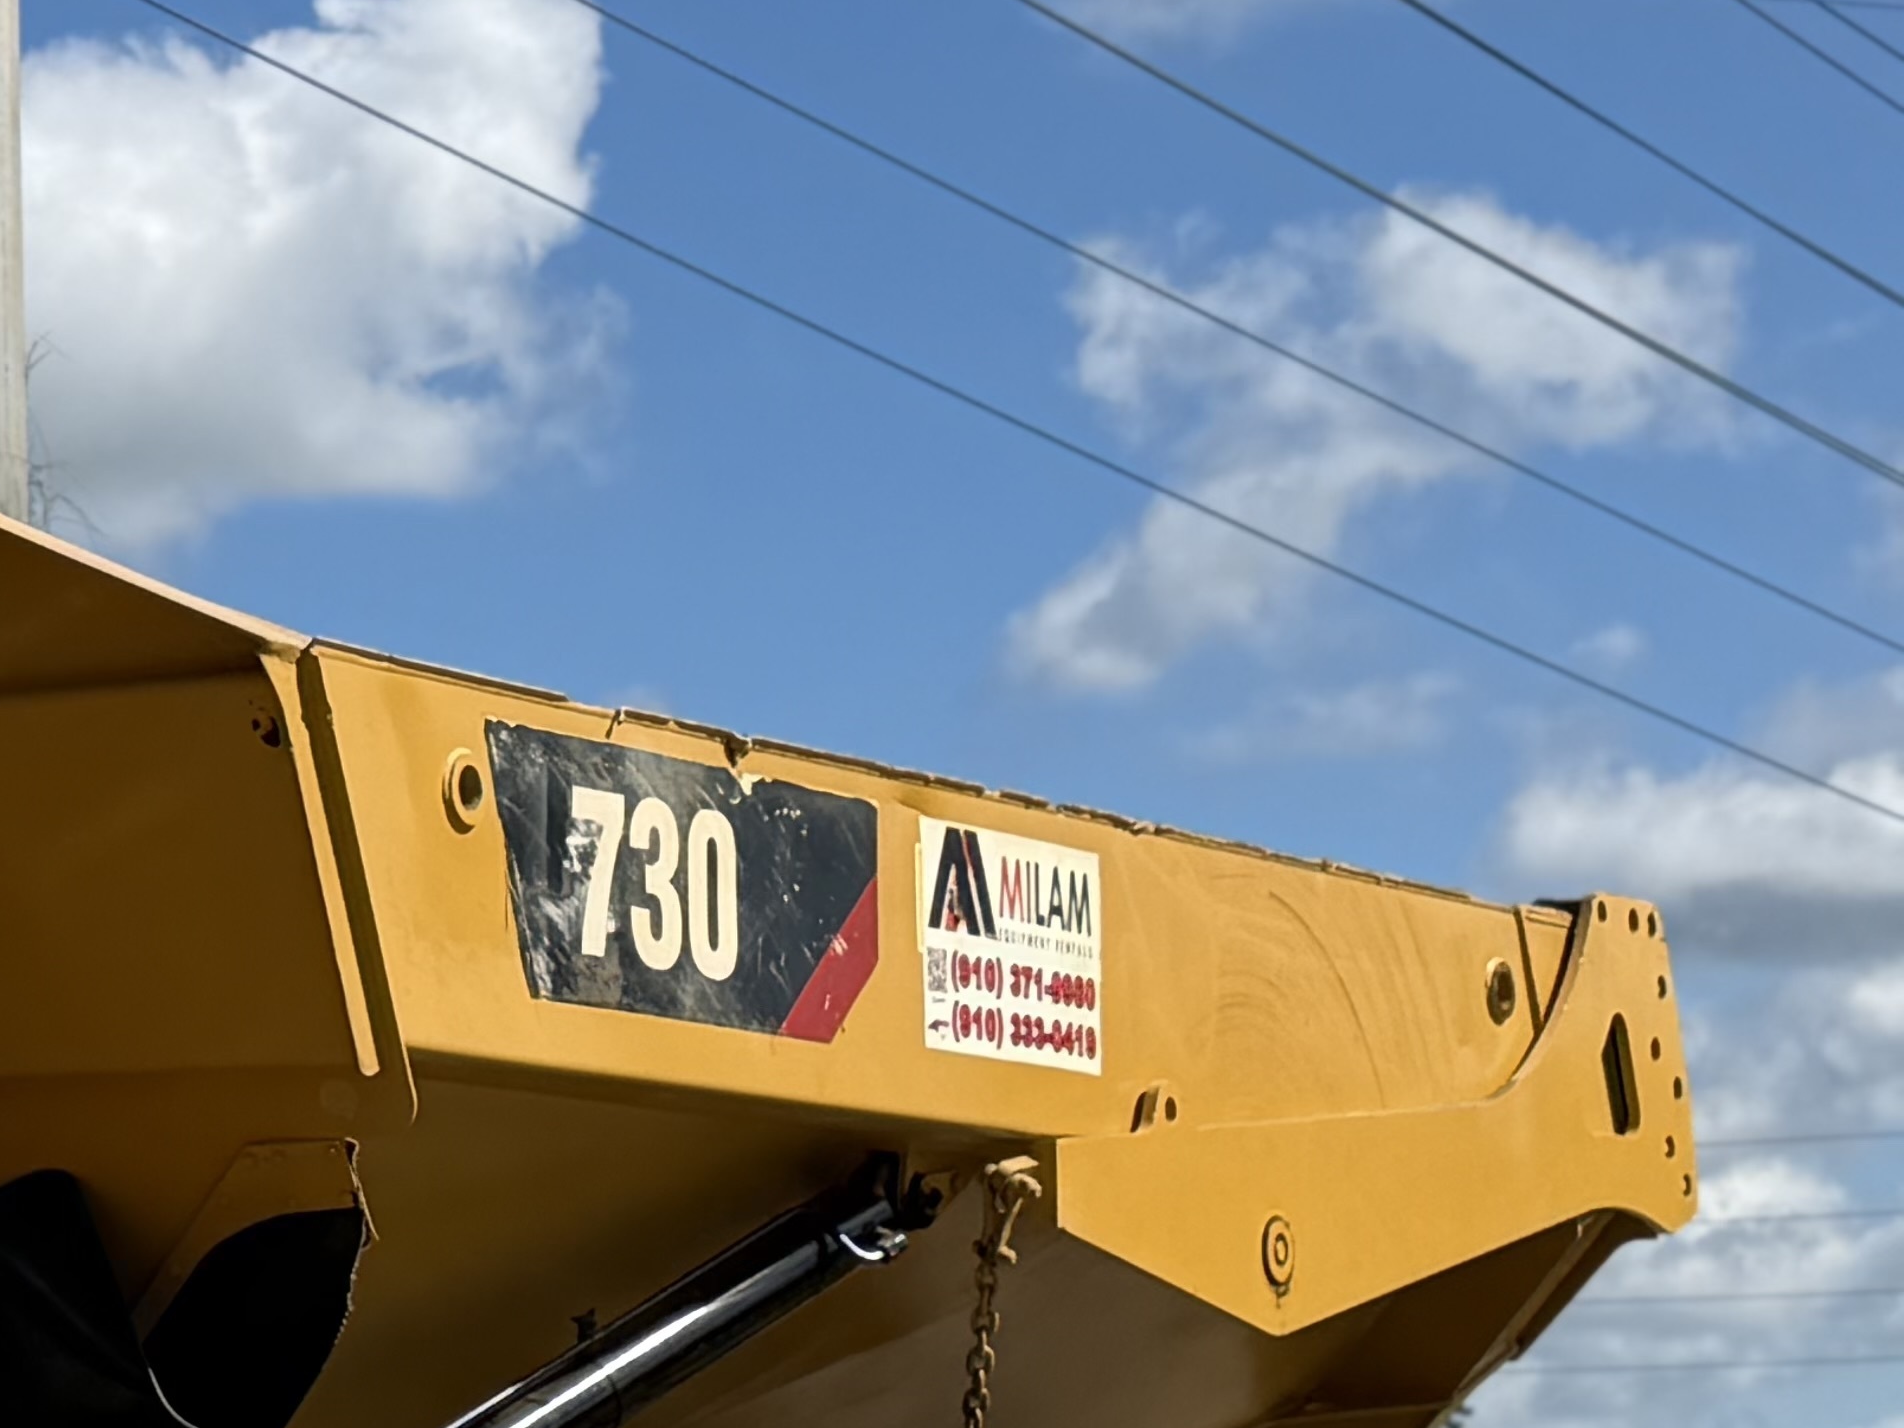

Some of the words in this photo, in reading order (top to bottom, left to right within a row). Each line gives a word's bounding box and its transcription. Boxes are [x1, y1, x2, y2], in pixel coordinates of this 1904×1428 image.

[571, 786, 738, 982] 730
[999, 855, 1092, 938] MILAM
[951, 949, 1004, 1000] (910)
[952, 1000, 1004, 1051] (910)
